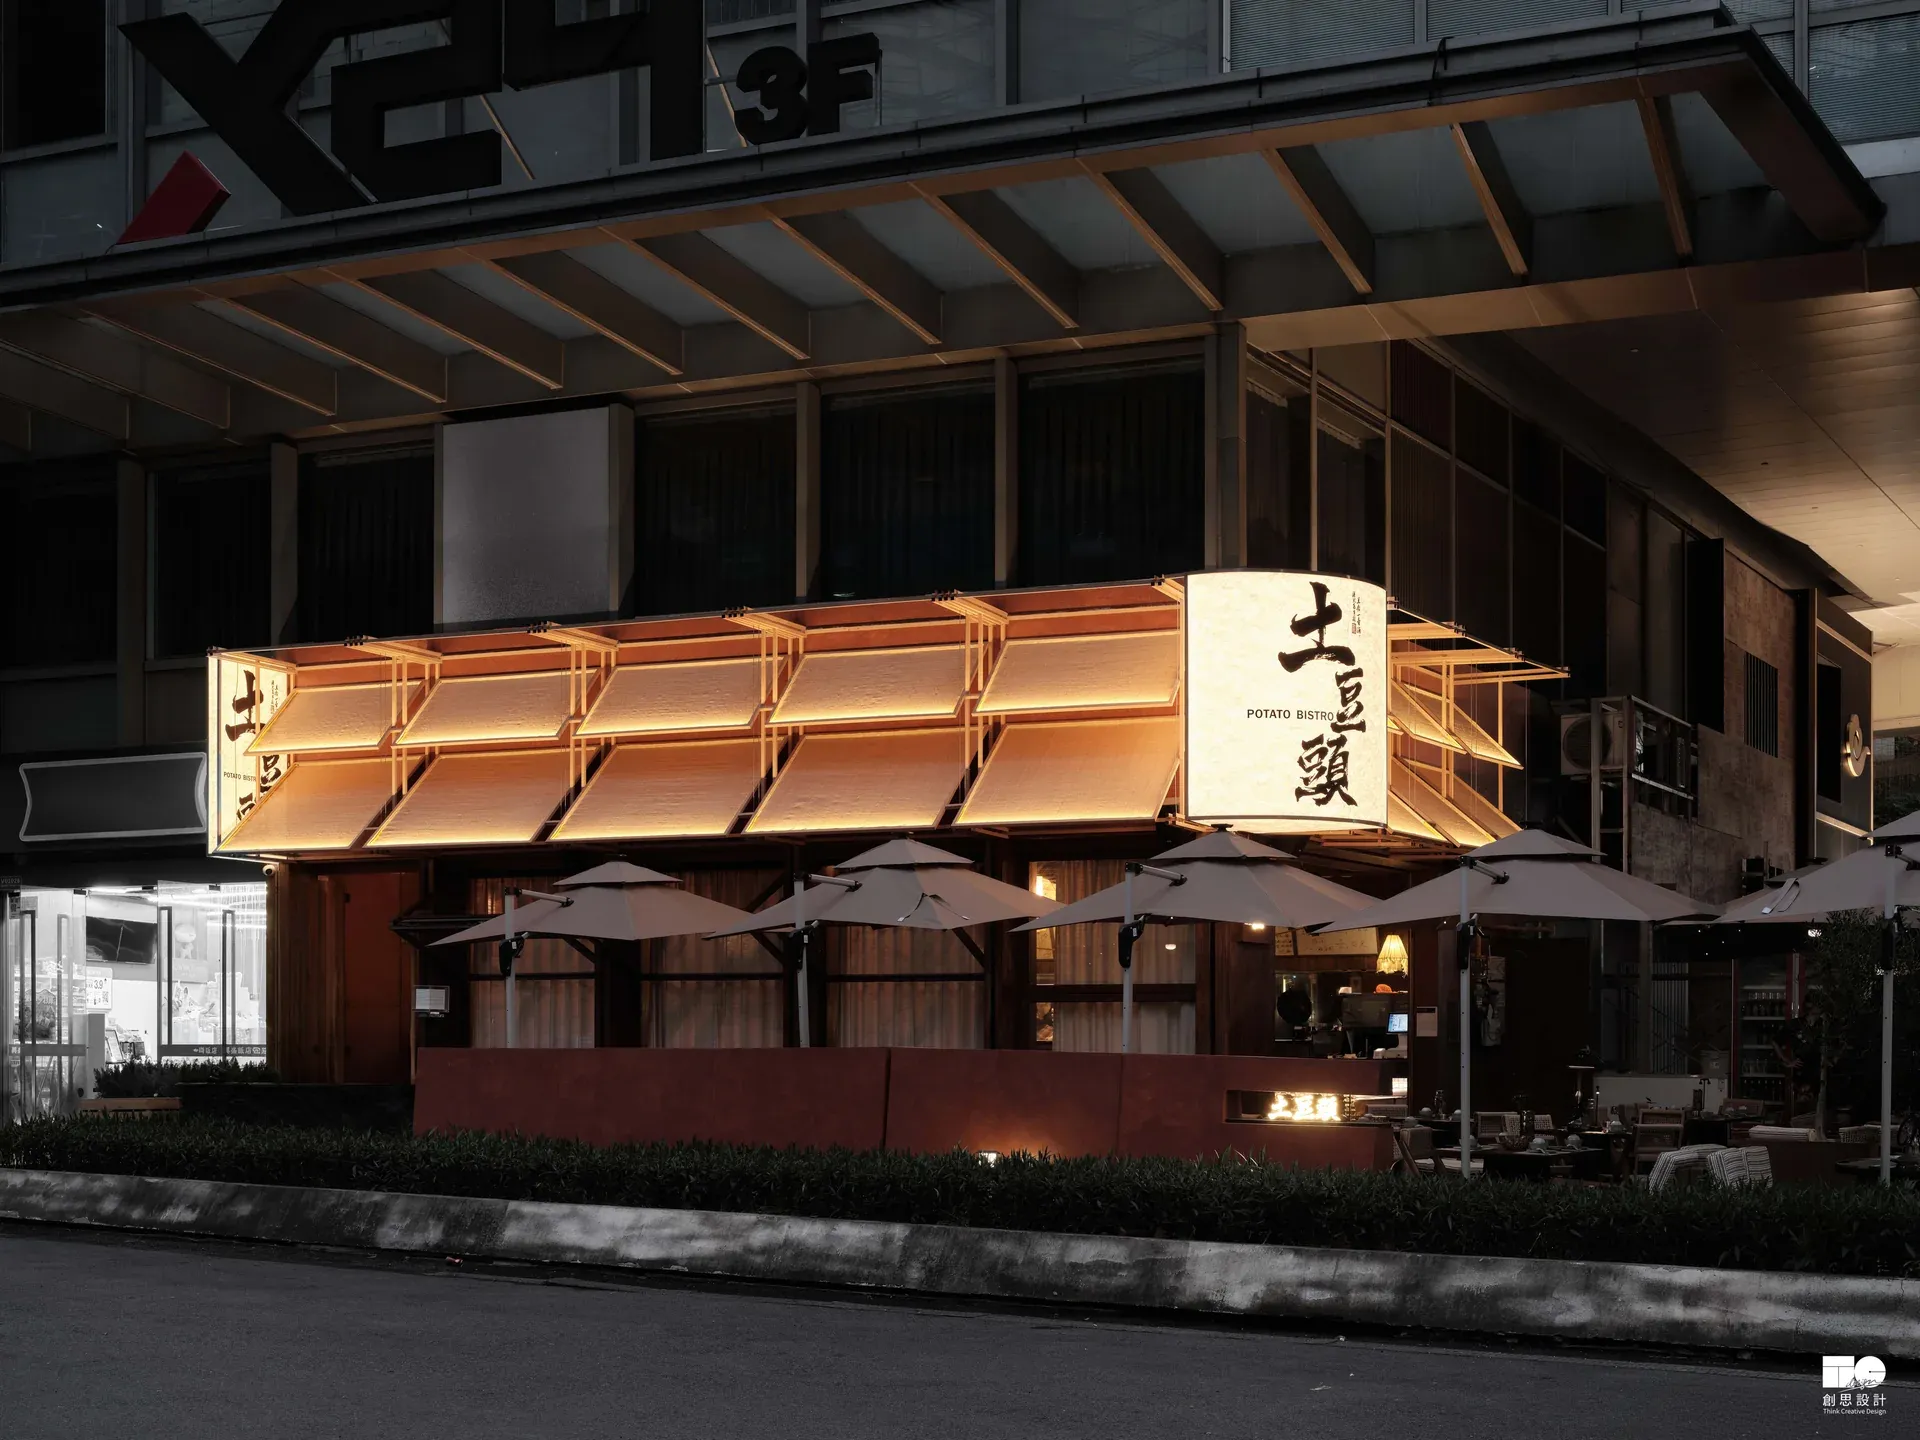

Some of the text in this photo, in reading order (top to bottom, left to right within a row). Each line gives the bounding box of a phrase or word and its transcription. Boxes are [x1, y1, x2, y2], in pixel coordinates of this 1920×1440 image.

[734, 33, 880, 146] 3F
[225, 669, 282, 821] 土豆
[1247, 708, 1334, 722] POTATO BISTRO
[1278, 581, 1367, 806] 土豆頭
[223, 771, 242, 780] POTATO
